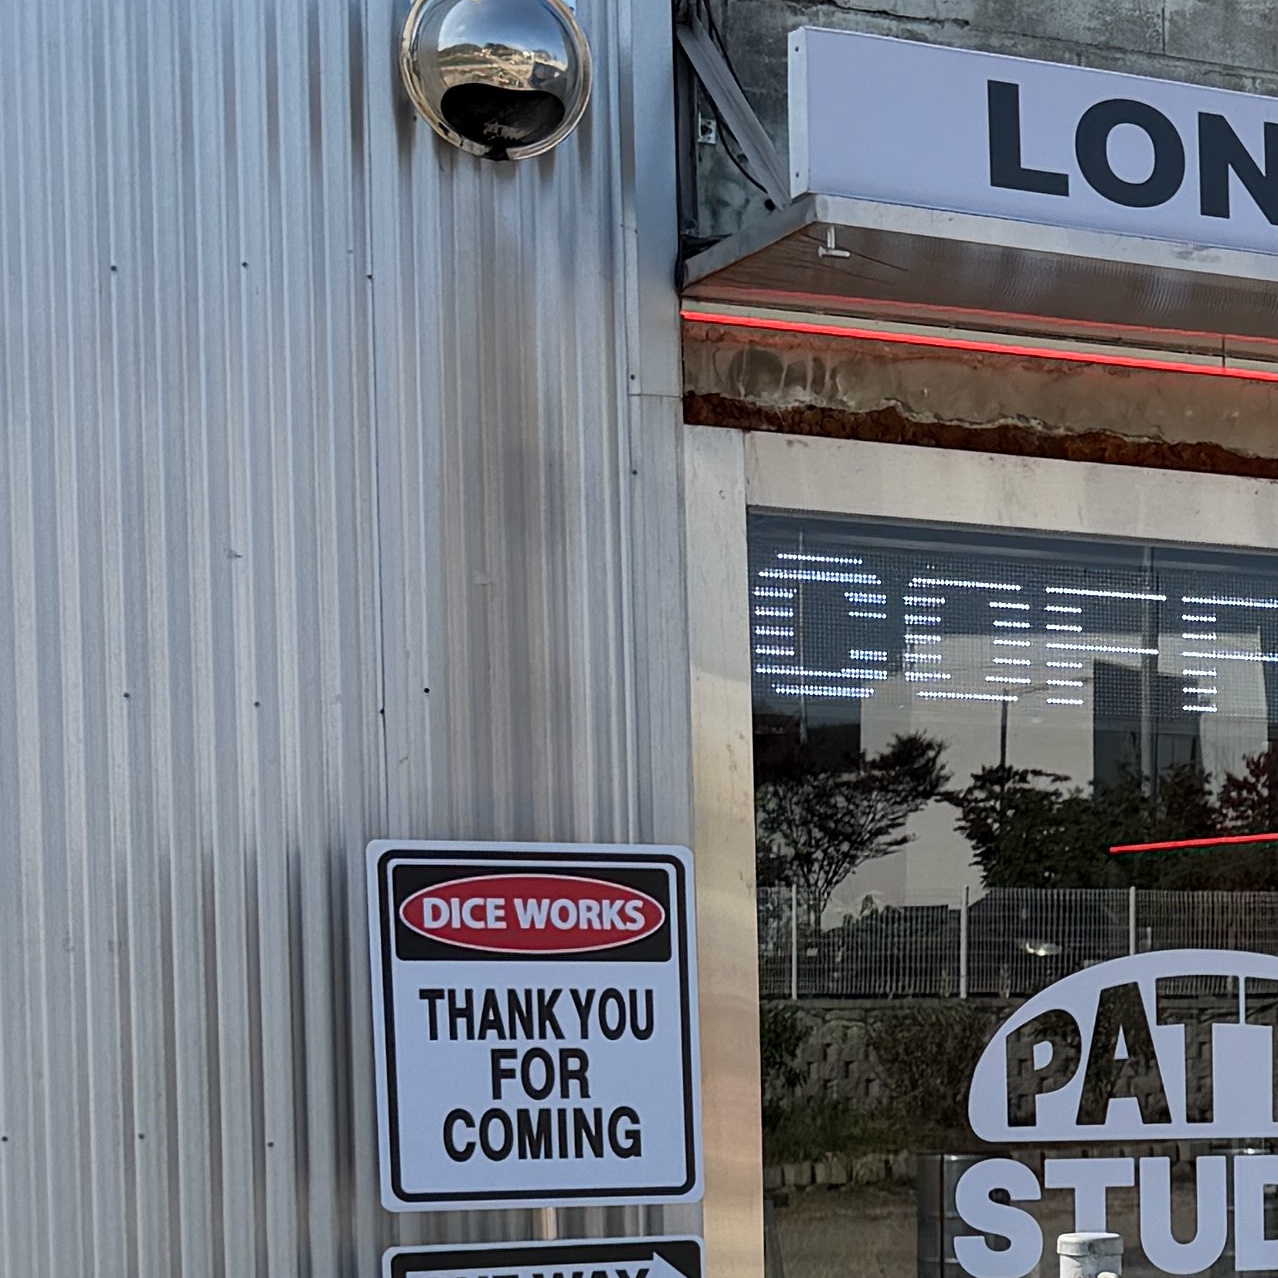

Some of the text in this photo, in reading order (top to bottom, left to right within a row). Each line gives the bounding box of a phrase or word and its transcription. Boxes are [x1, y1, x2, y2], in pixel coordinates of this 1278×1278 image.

[422, 897, 646, 931] DICE WORKS
[419, 987, 655, 1042] THANK YOU
[489, 1046, 593, 1102] FOR
[442, 1105, 643, 1164] COMING
